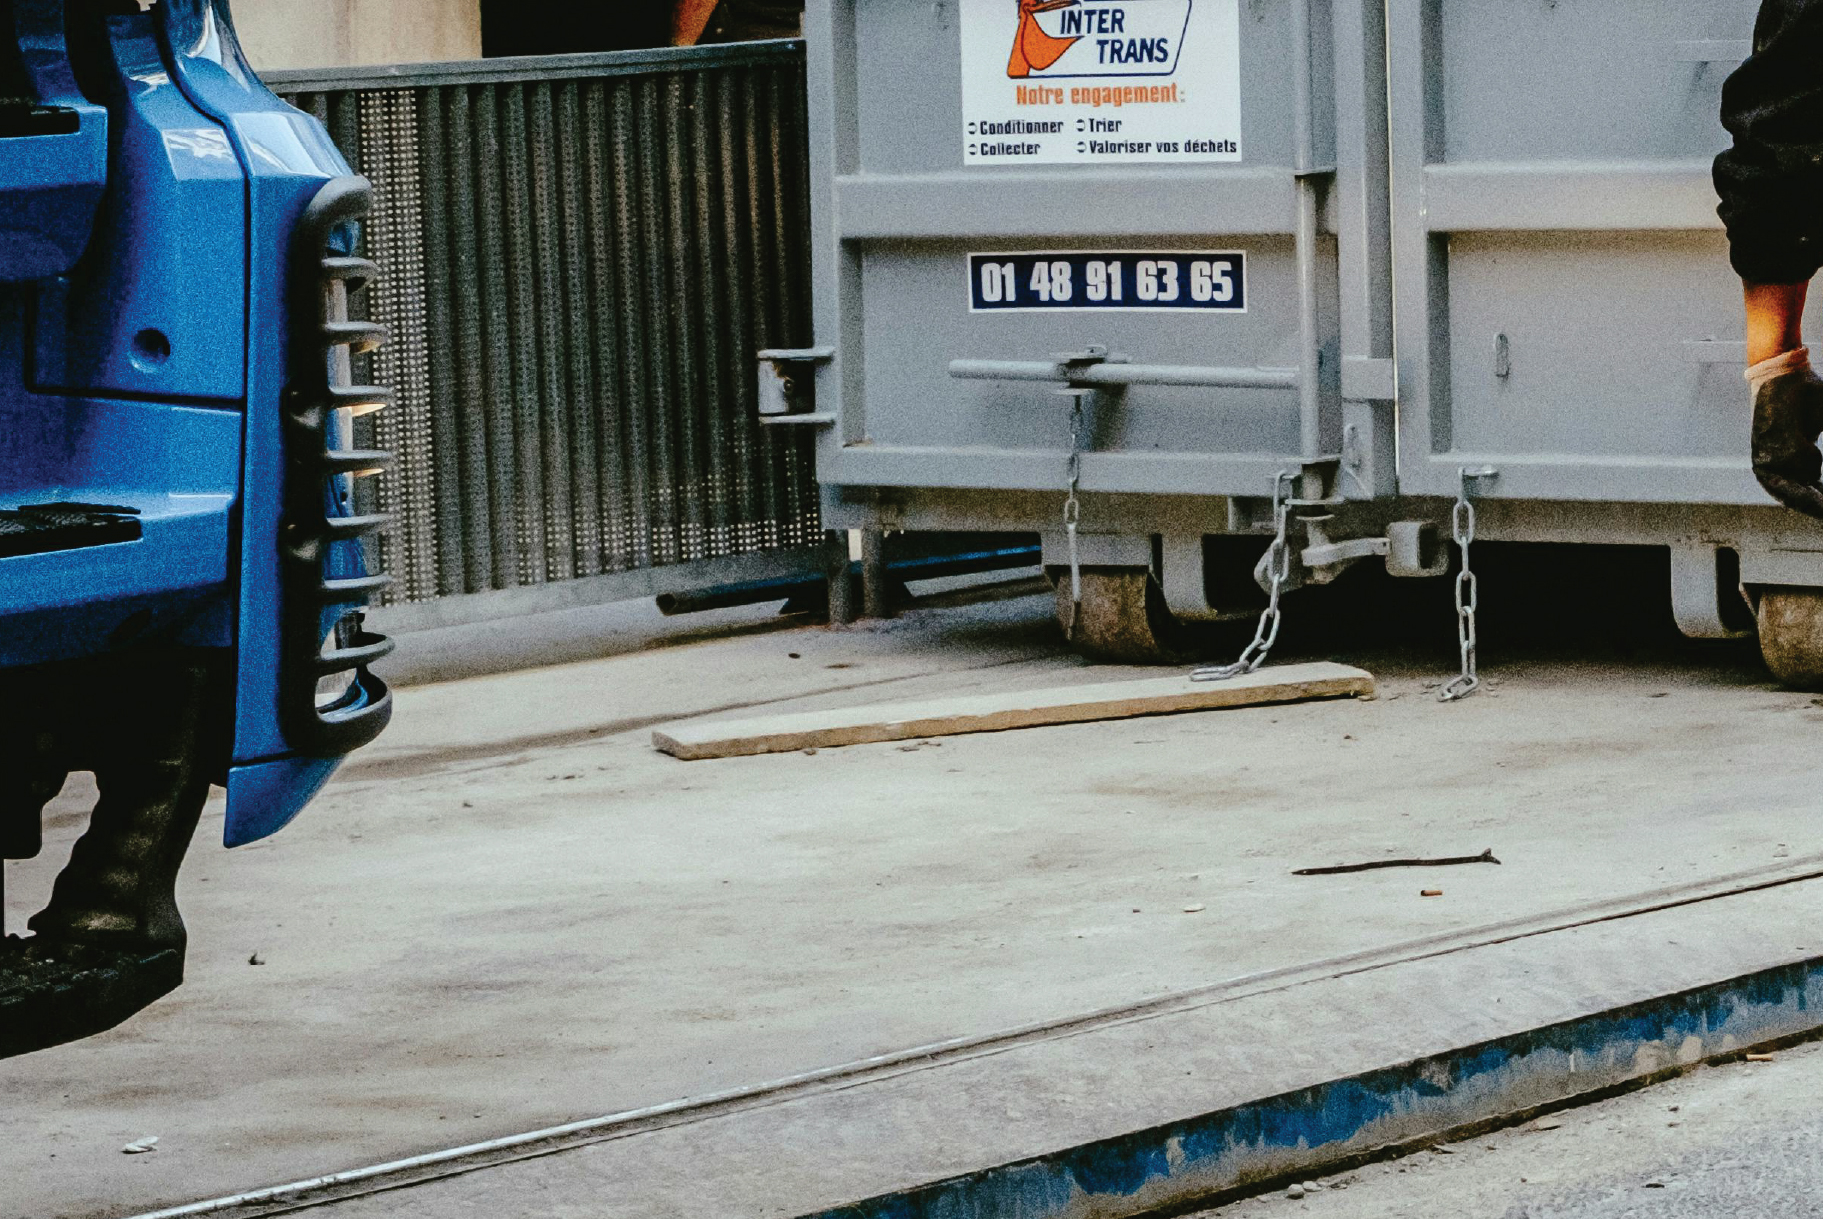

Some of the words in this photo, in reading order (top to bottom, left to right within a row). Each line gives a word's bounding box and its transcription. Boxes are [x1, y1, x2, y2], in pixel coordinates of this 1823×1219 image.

[1060, 9, 1125, 35] INTER
[1096, 37, 1169, 64] TRANS
[1016, 85, 1064, 106] Notre
[980, 120, 1064, 136] Conditionner
[1088, 118, 1123, 133] Trier
[980, 142, 1041, 156] Collecter
[1088, 139, 1152, 155] Valoriser
[1156, 141, 1179, 154] vos
[1184, 139, 1238, 154] déchets
[980, 262, 1017, 302] 01
[1029, 261, 1073, 302] 48
[1085, 260, 1122, 301] 91
[1136, 260, 1180, 301] 63
[1190, 260, 1234, 302] 65
